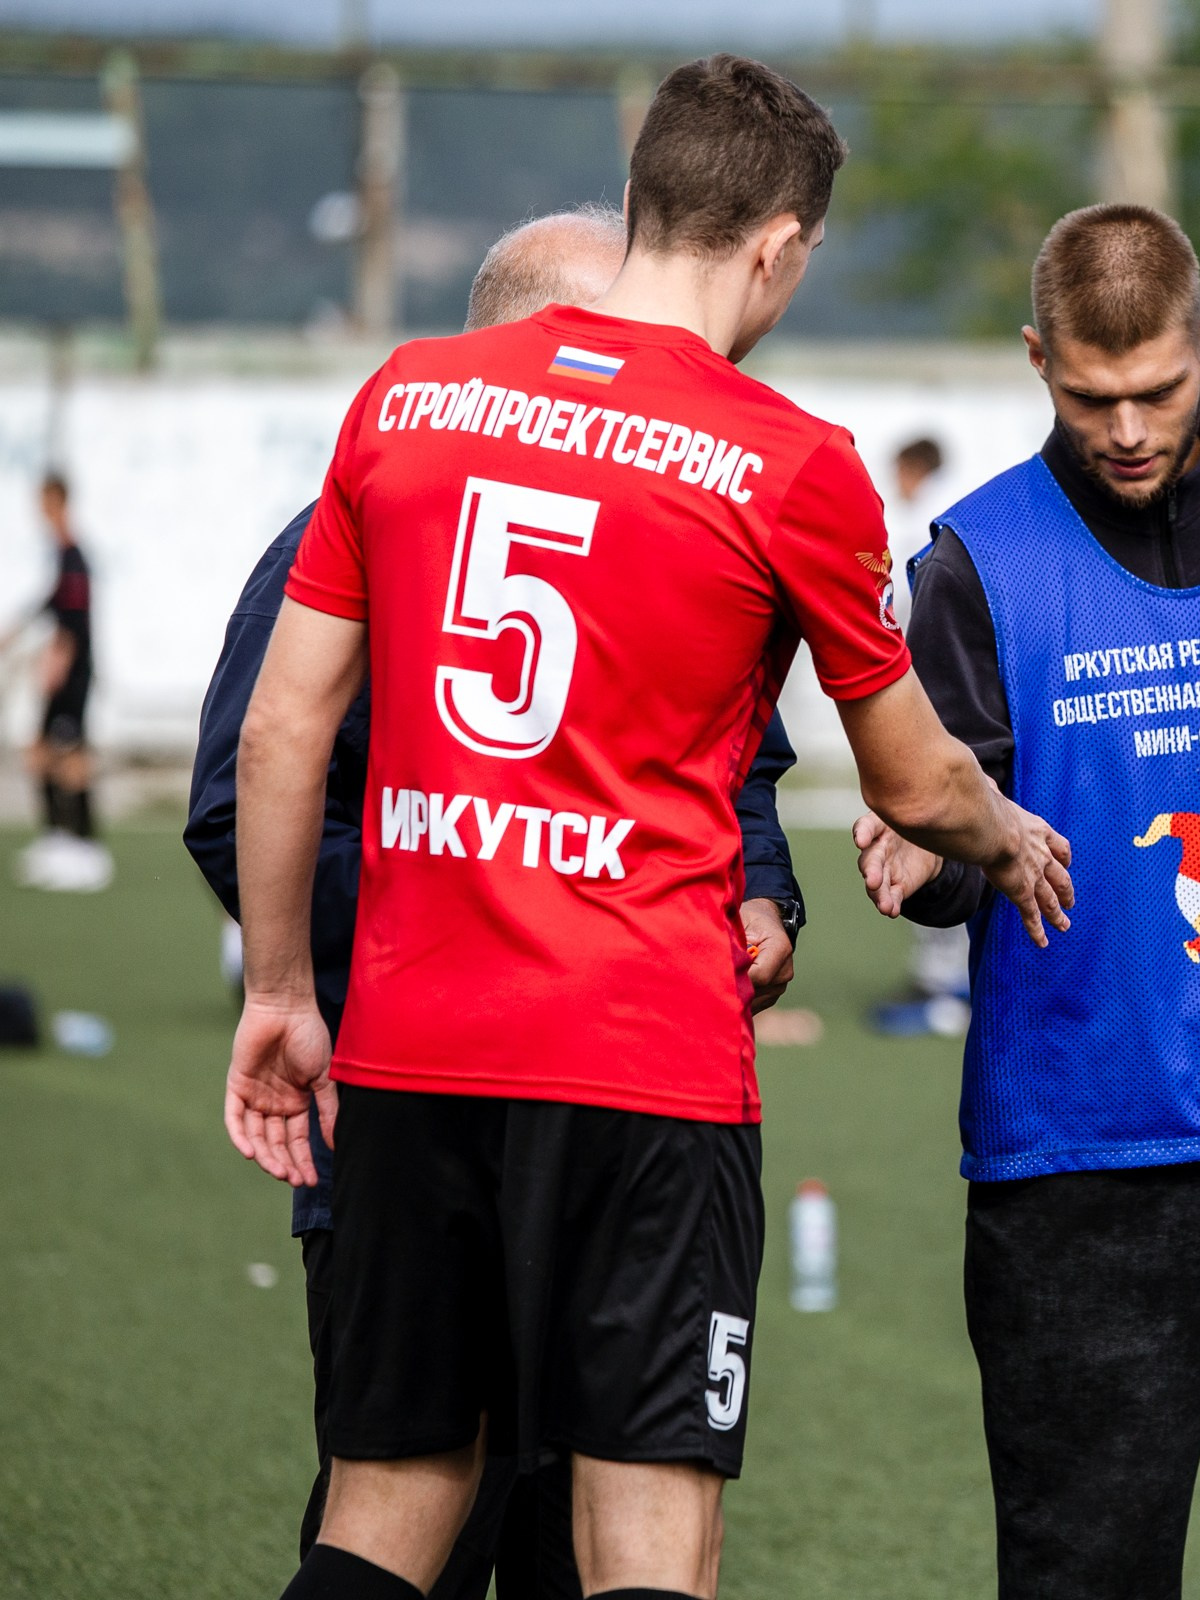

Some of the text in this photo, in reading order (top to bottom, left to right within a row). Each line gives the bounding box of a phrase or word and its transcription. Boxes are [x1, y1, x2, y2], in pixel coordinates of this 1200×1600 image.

[377, 377, 763, 505] СТРОЙПРОЕКТСЕРВИС
[434, 476, 601, 760] 5
[381, 786, 636, 880] ИРКУТСК
[704, 1310, 750, 1431] 5
